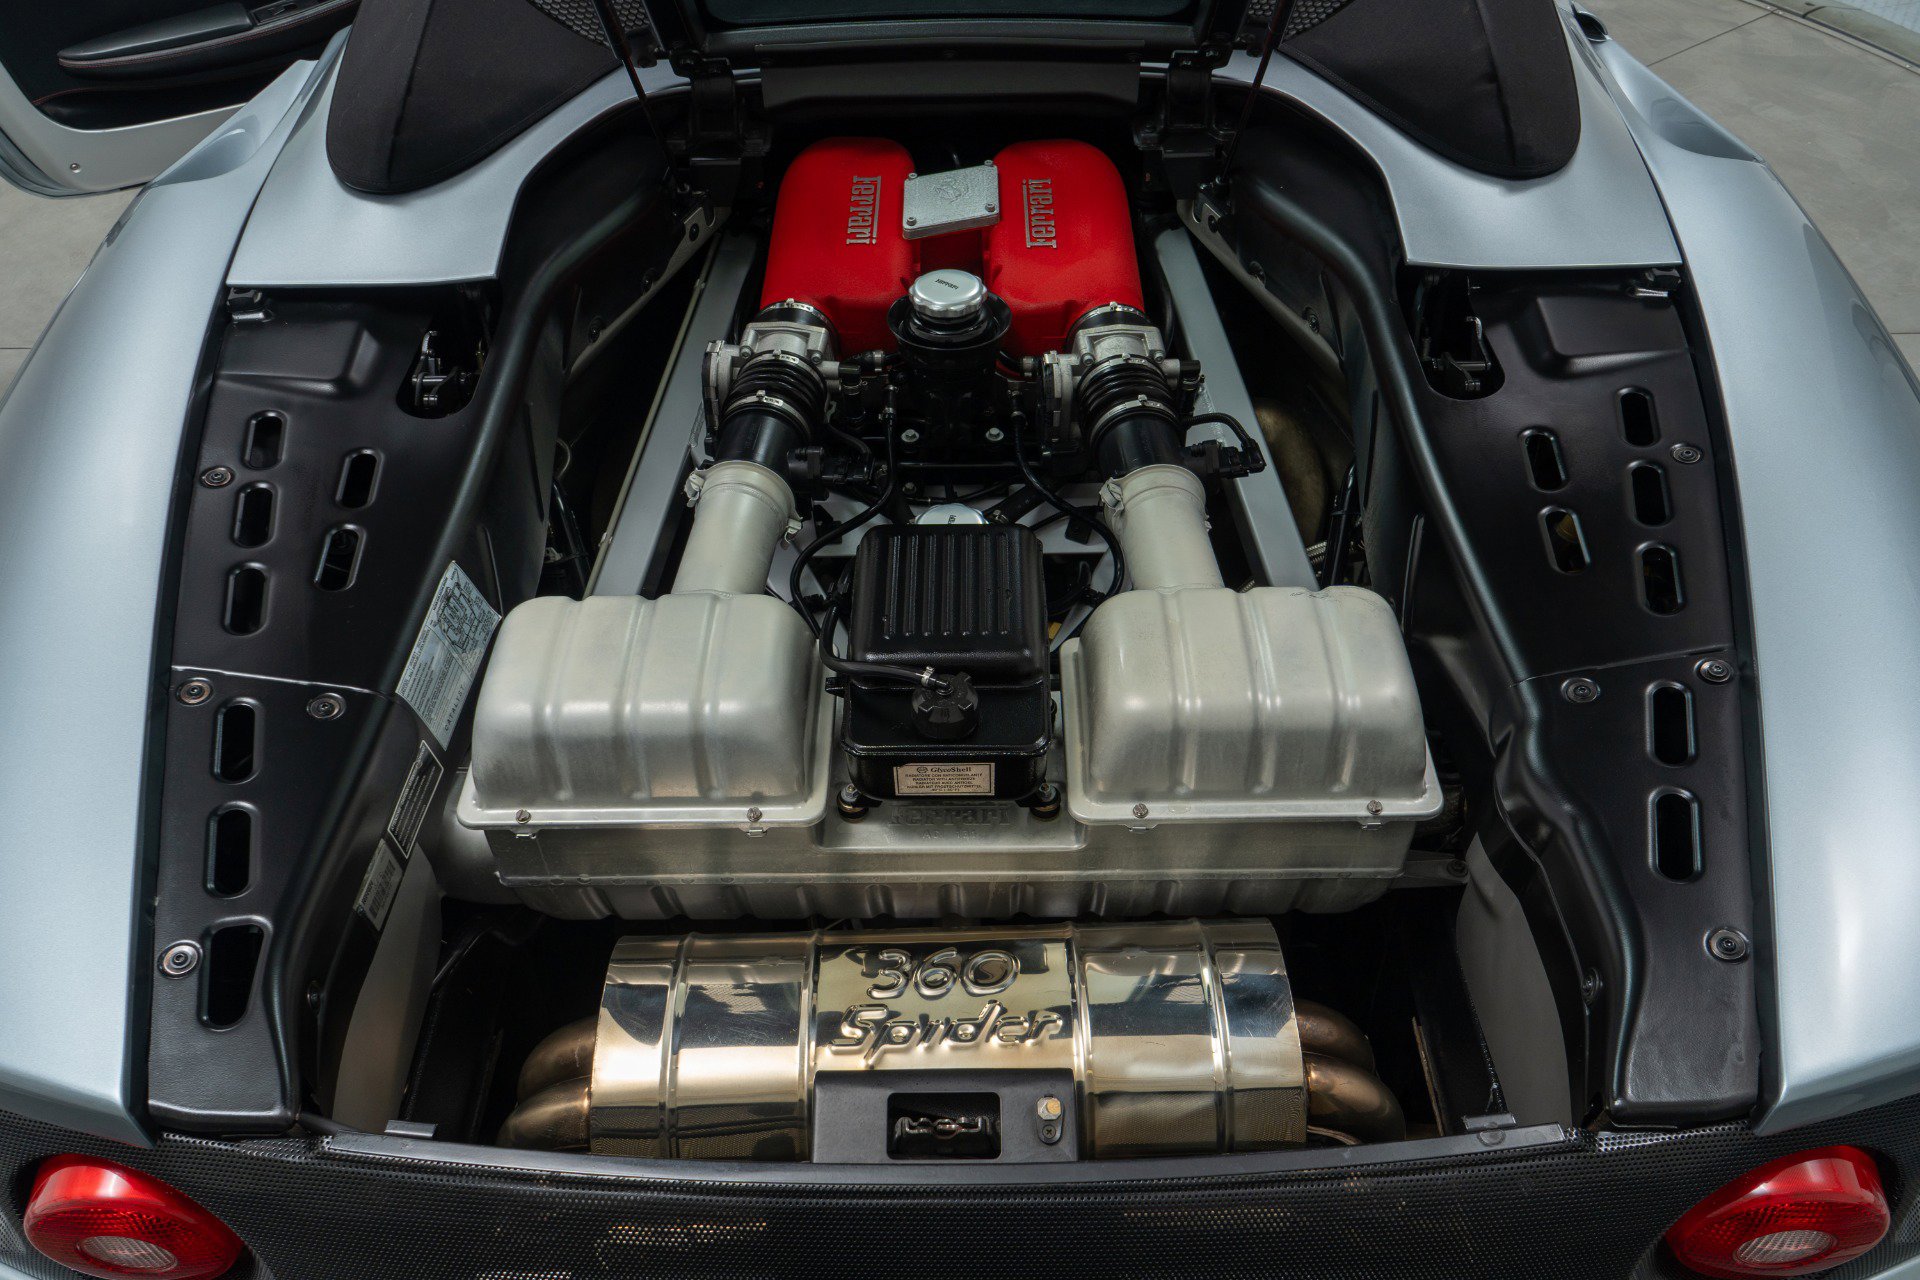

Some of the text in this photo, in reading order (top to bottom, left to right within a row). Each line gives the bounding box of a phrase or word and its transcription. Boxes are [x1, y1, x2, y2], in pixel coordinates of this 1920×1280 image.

[845, 175, 882, 246] Ferrari
[1022, 178, 1057, 249] Ferrari
[444, 683, 465, 732] CATALYST
[930, 766, 972, 774] GlycoShell
[866, 946, 1021, 1001] 360
[825, 999, 1063, 1069] Spider
